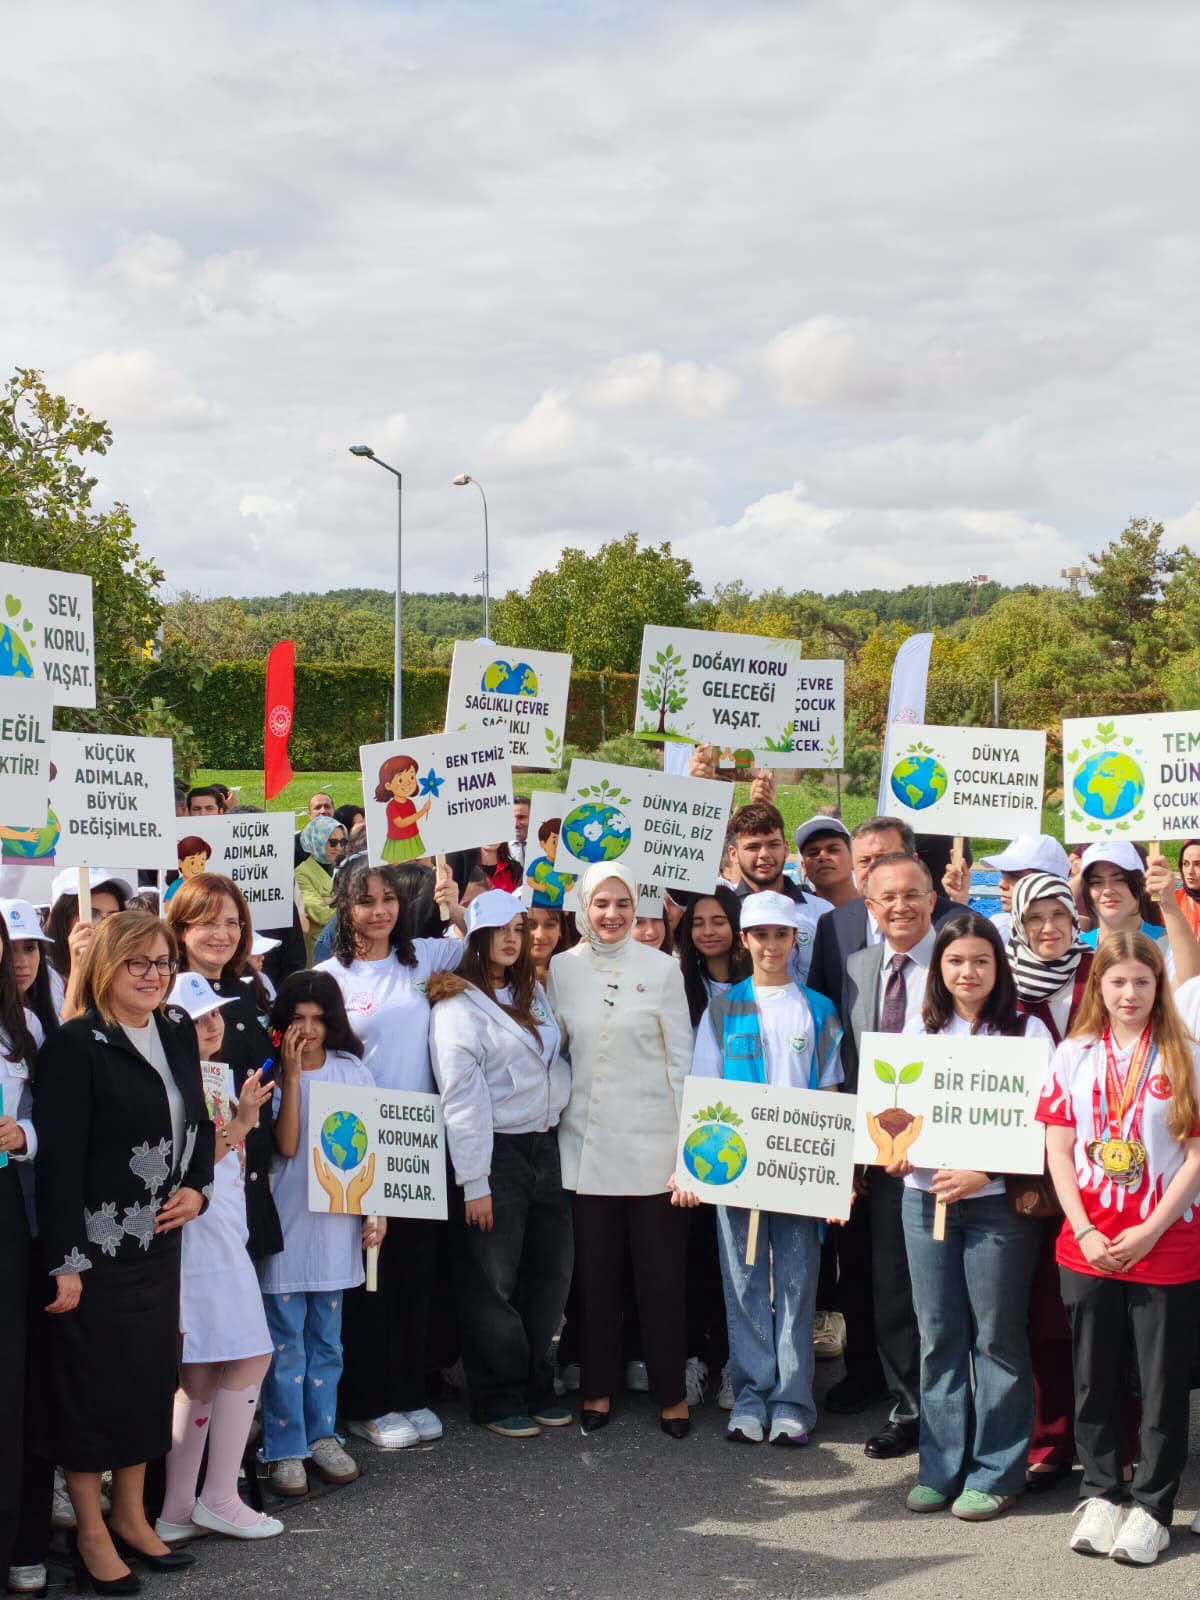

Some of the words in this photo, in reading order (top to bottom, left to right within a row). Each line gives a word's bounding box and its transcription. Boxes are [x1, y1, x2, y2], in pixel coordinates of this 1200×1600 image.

[48, 593, 81, 622] SEV,
[43, 626, 90, 657] KORU,
[692, 650, 745, 673] DOĞAYI
[748, 658, 788, 677] KORU
[42, 661, 93, 691] YAŞAT.
[796, 677, 834, 691] EVRE
[702, 680, 776, 703] GELECEĞİ
[465, 693, 514, 713] SAĞLIKLI
[515, 700, 550, 717] ÇEVRE
[0, 713, 46, 744] EĞİL
[712, 707, 761, 730] YAŞAT.
[792, 717, 820, 733] ENLİ
[84, 742, 136, 765] KÜÇÜK
[972, 743, 1020, 763] DÜNYA
[1162, 731, 1200, 753] TEM
[0, 753, 39, 776] KTİR!
[445, 753, 469, 769] BEN
[470, 745, 505, 764] TEMİZ
[74, 768, 149, 789] ADIMLAR,
[457, 771, 497, 793] HAVA
[953, 769, 1039, 787] ÇOCUKLARIN
[1160, 758, 1200, 784] DÜN
[87, 791, 138, 812] BÜYÜK
[447, 794, 511, 817] İSTİYORUM.
[642, 794, 688, 812] DÜNYA
[691, 801, 723, 820] BİZE
[953, 791, 1038, 810] EMANETİDİR.
[1153, 791, 1200, 811] ÇOCUK
[69, 816, 162, 840] DEĞİŞİMLER.
[232, 821, 270, 841] KÜÇÜK
[643, 818, 686, 839] DEĞİL,
[690, 825, 713, 842] BİZ
[1162, 815, 1200, 831] HAKK
[223, 843, 278, 860] ADIMLAR,
[643, 838, 706, 864] DÜNYAYA
[231, 863, 269, 882] BÜYÜK
[651, 861, 691, 881] AİTİZ.
[240, 887, 285, 904] ŞİMLER.
[638, 883, 661, 899] AR.
[933, 1067, 964, 1091] BİR
[970, 1069, 1030, 1097] FİDAN,
[379, 1103, 435, 1124] GELECEĞİ
[750, 1106, 780, 1123] GERİ
[782, 1108, 855, 1134] DÖNÜŞTÜR,
[931, 1101, 963, 1125] BİR
[968, 1107, 1028, 1128] UMUT.
[378, 1128, 439, 1150] KORUMAK
[766, 1134, 836, 1158] GELECEĞİ
[387, 1154, 430, 1175] BUGÜN
[756, 1159, 840, 1186] DÖNÜŞTÜR.
[383, 1182, 436, 1203] BAŞLAR.
